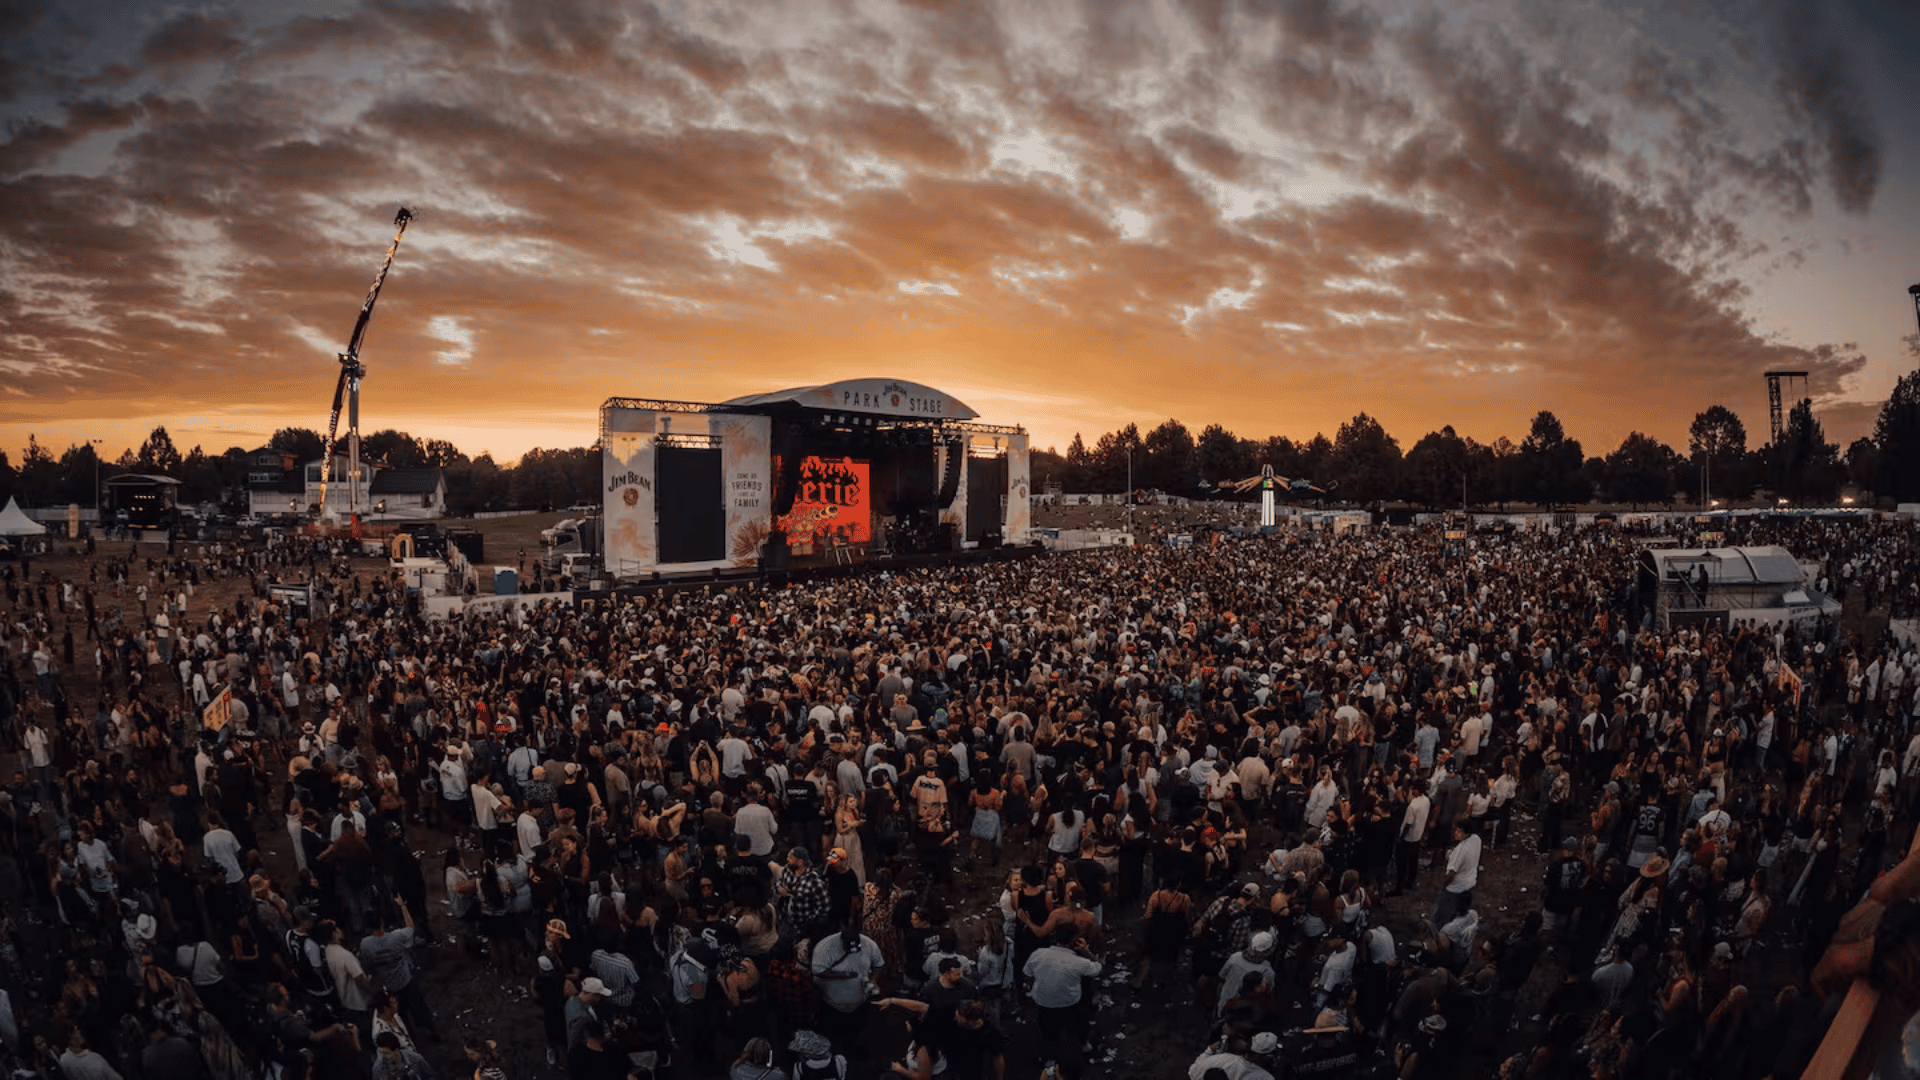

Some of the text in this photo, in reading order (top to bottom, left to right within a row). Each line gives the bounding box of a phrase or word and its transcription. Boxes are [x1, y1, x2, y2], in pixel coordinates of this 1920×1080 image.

[844, 391, 880, 408] PARK
[910, 398, 942, 413] STAGE
[608, 471, 651, 492] JIM BEAM
[731, 480, 763, 491] FRIENDS
[734, 498, 760, 507] FAMILY
[1638, 813, 1657, 831] 96
